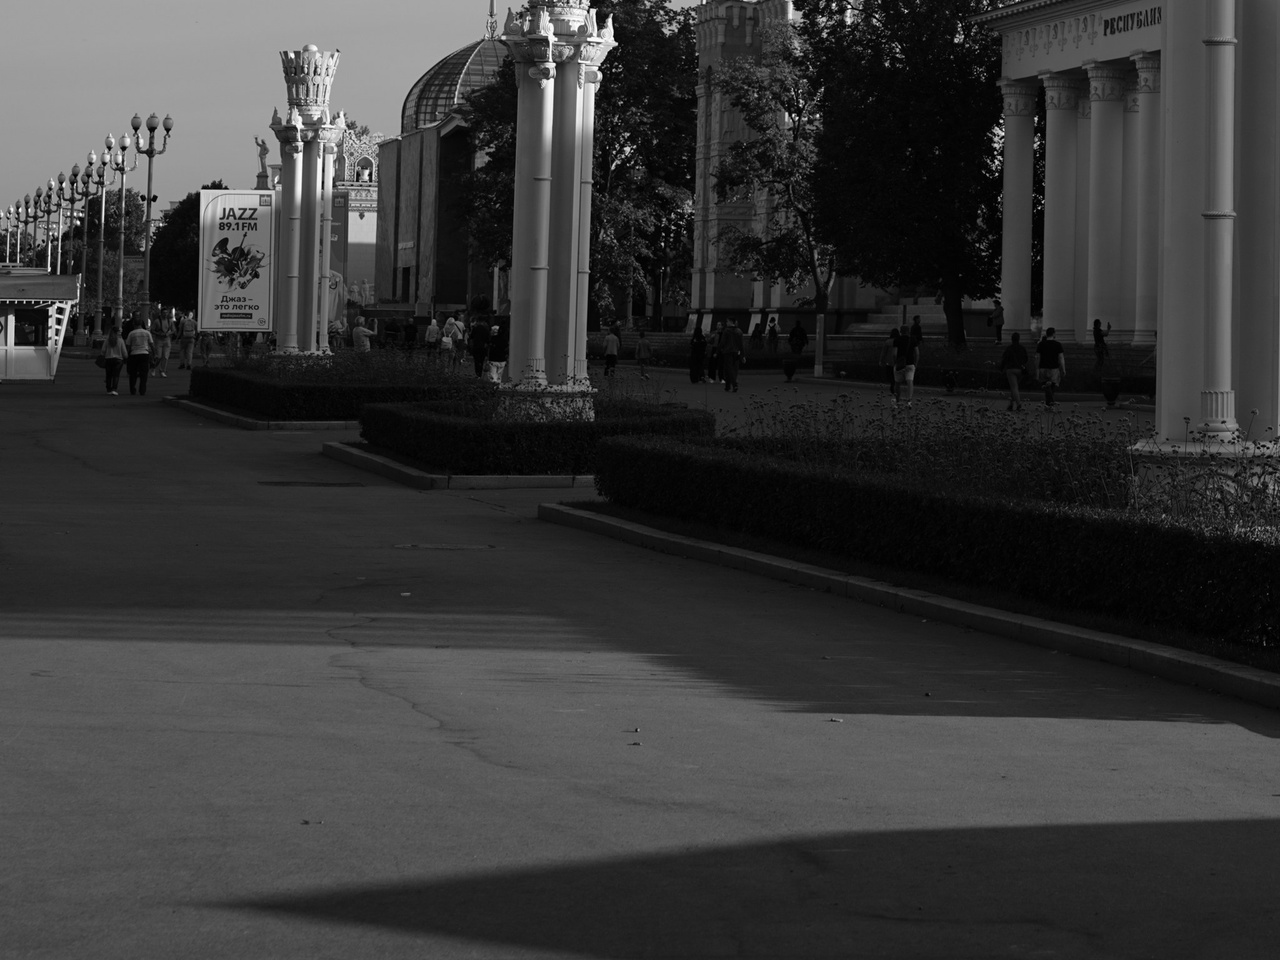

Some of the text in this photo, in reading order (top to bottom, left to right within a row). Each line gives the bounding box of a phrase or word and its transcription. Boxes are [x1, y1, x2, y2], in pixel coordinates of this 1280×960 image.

[219, 207, 258, 220] JAZZ
[219, 222, 258, 231] 89.1 FM
[220, 295, 246, 304] Джаз
